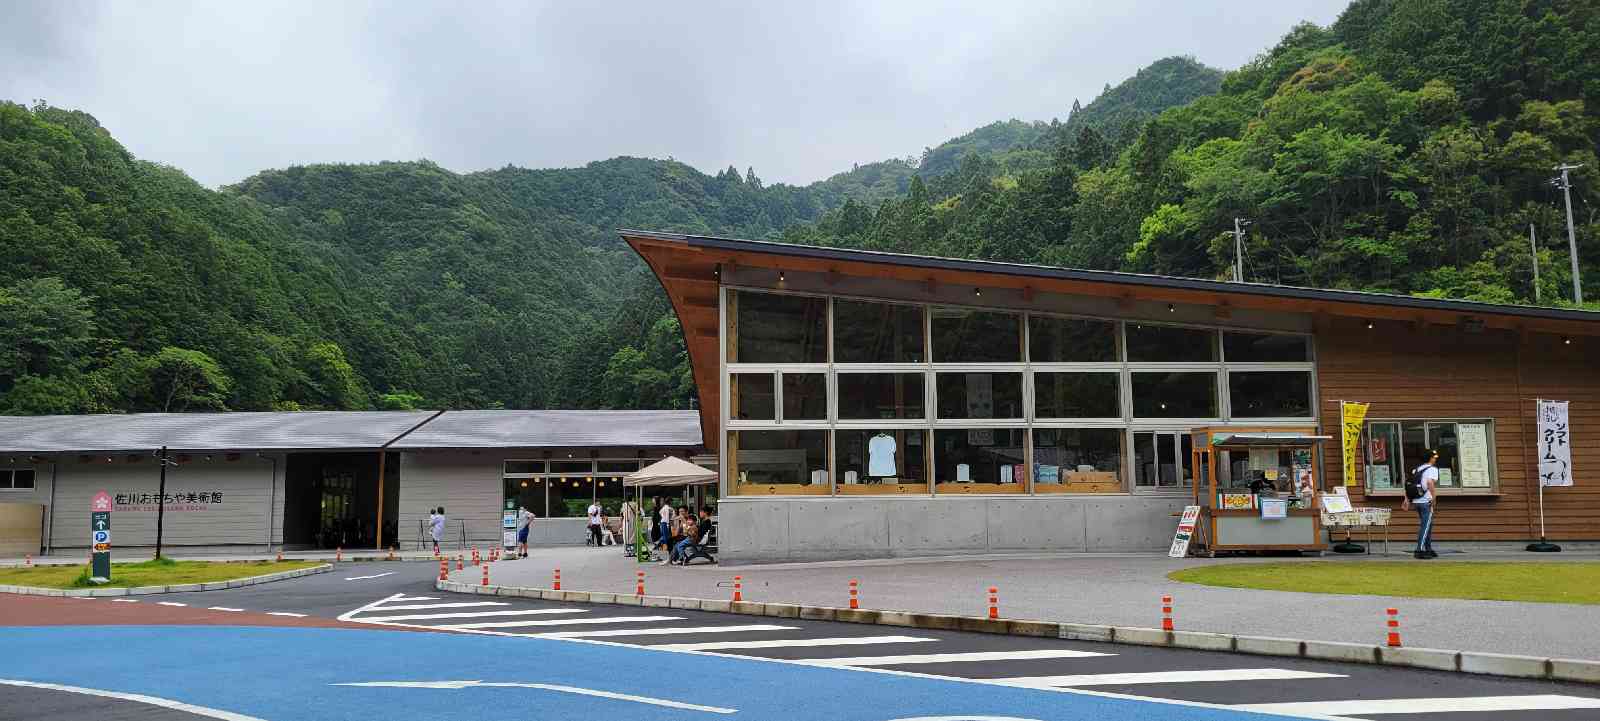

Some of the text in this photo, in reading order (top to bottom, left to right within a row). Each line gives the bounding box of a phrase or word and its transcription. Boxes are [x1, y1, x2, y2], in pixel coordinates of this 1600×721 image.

[1544, 428, 1556, 460] クリーム
[1556, 423, 1567, 445] ソフト
